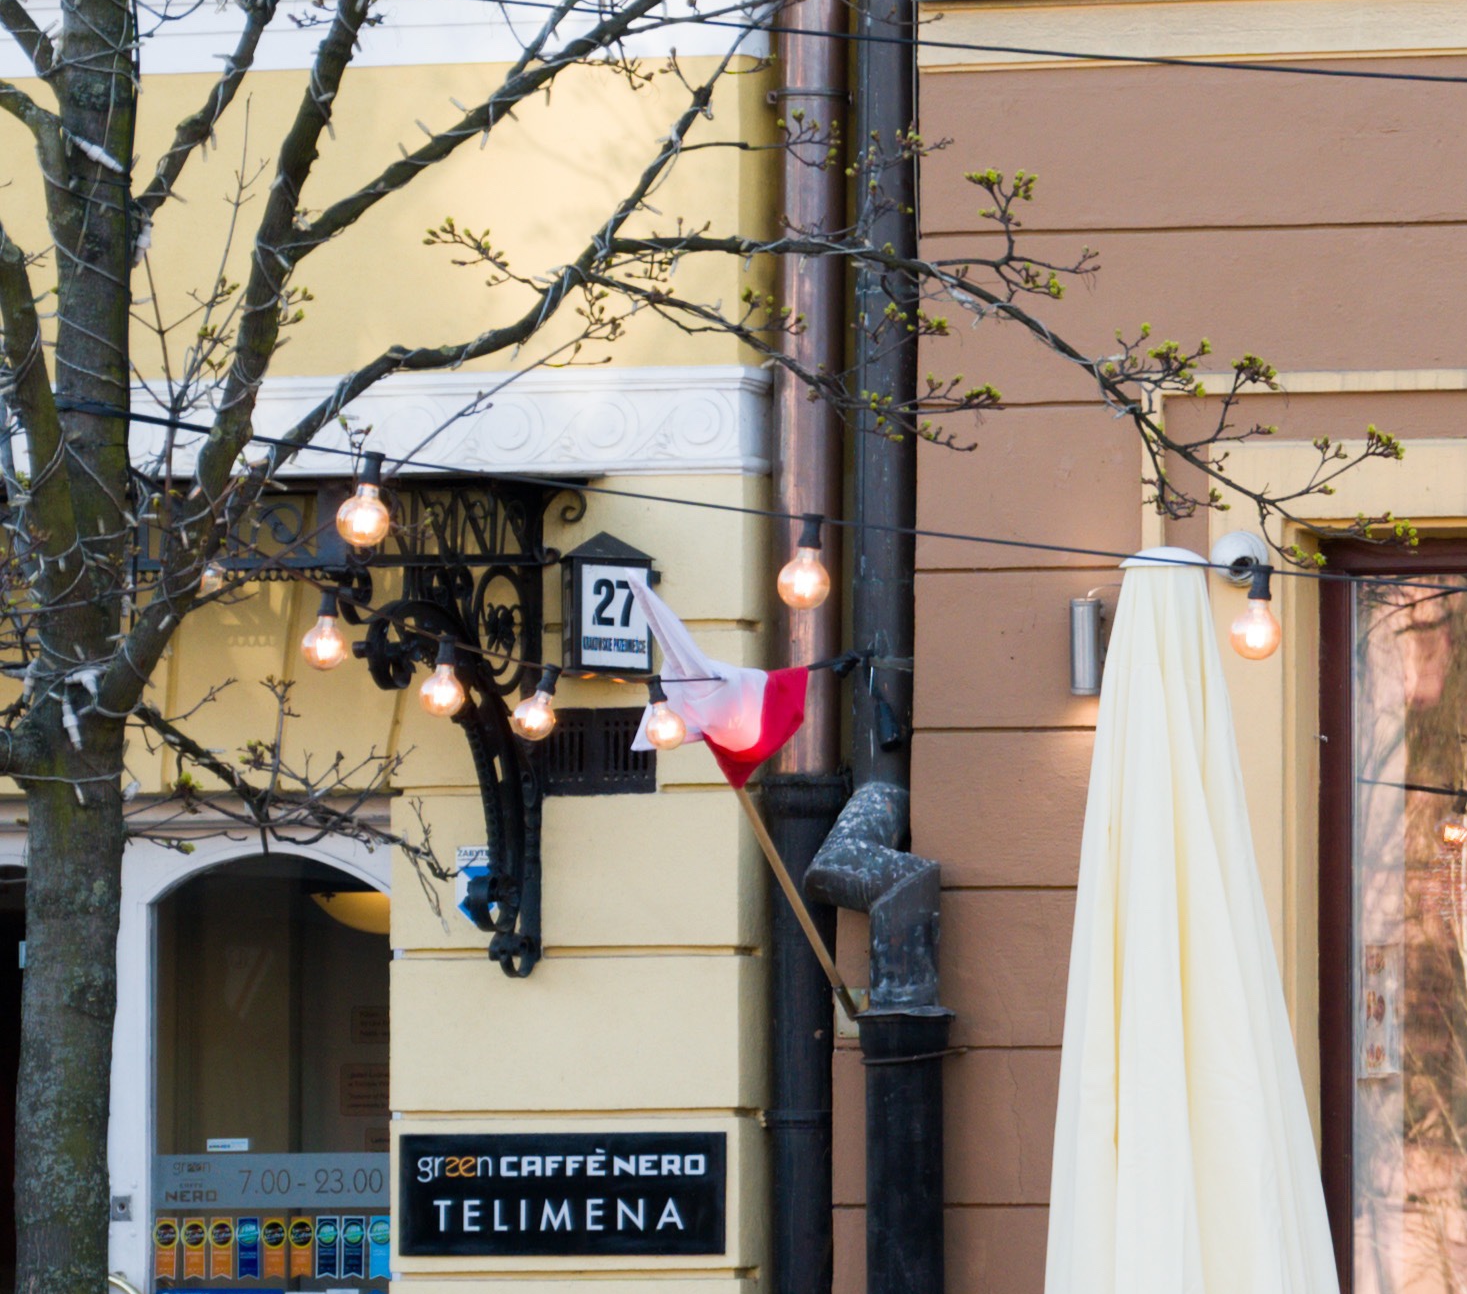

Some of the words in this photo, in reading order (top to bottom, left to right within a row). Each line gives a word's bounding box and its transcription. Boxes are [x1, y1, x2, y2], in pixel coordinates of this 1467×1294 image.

[592, 578, 637, 628] 27
[458, 849, 488, 857] ZABYT
[416, 1156, 493, 1183] green
[500, 1148, 606, 1177] CAFFÈ
[613, 1154, 705, 1176] NERO
[238, 1169, 291, 1194] 7.00
[314, 1168, 384, 1194] 23.00
[165, 1190, 218, 1203] NERO
[433, 1198, 684, 1232] TELIMENA
